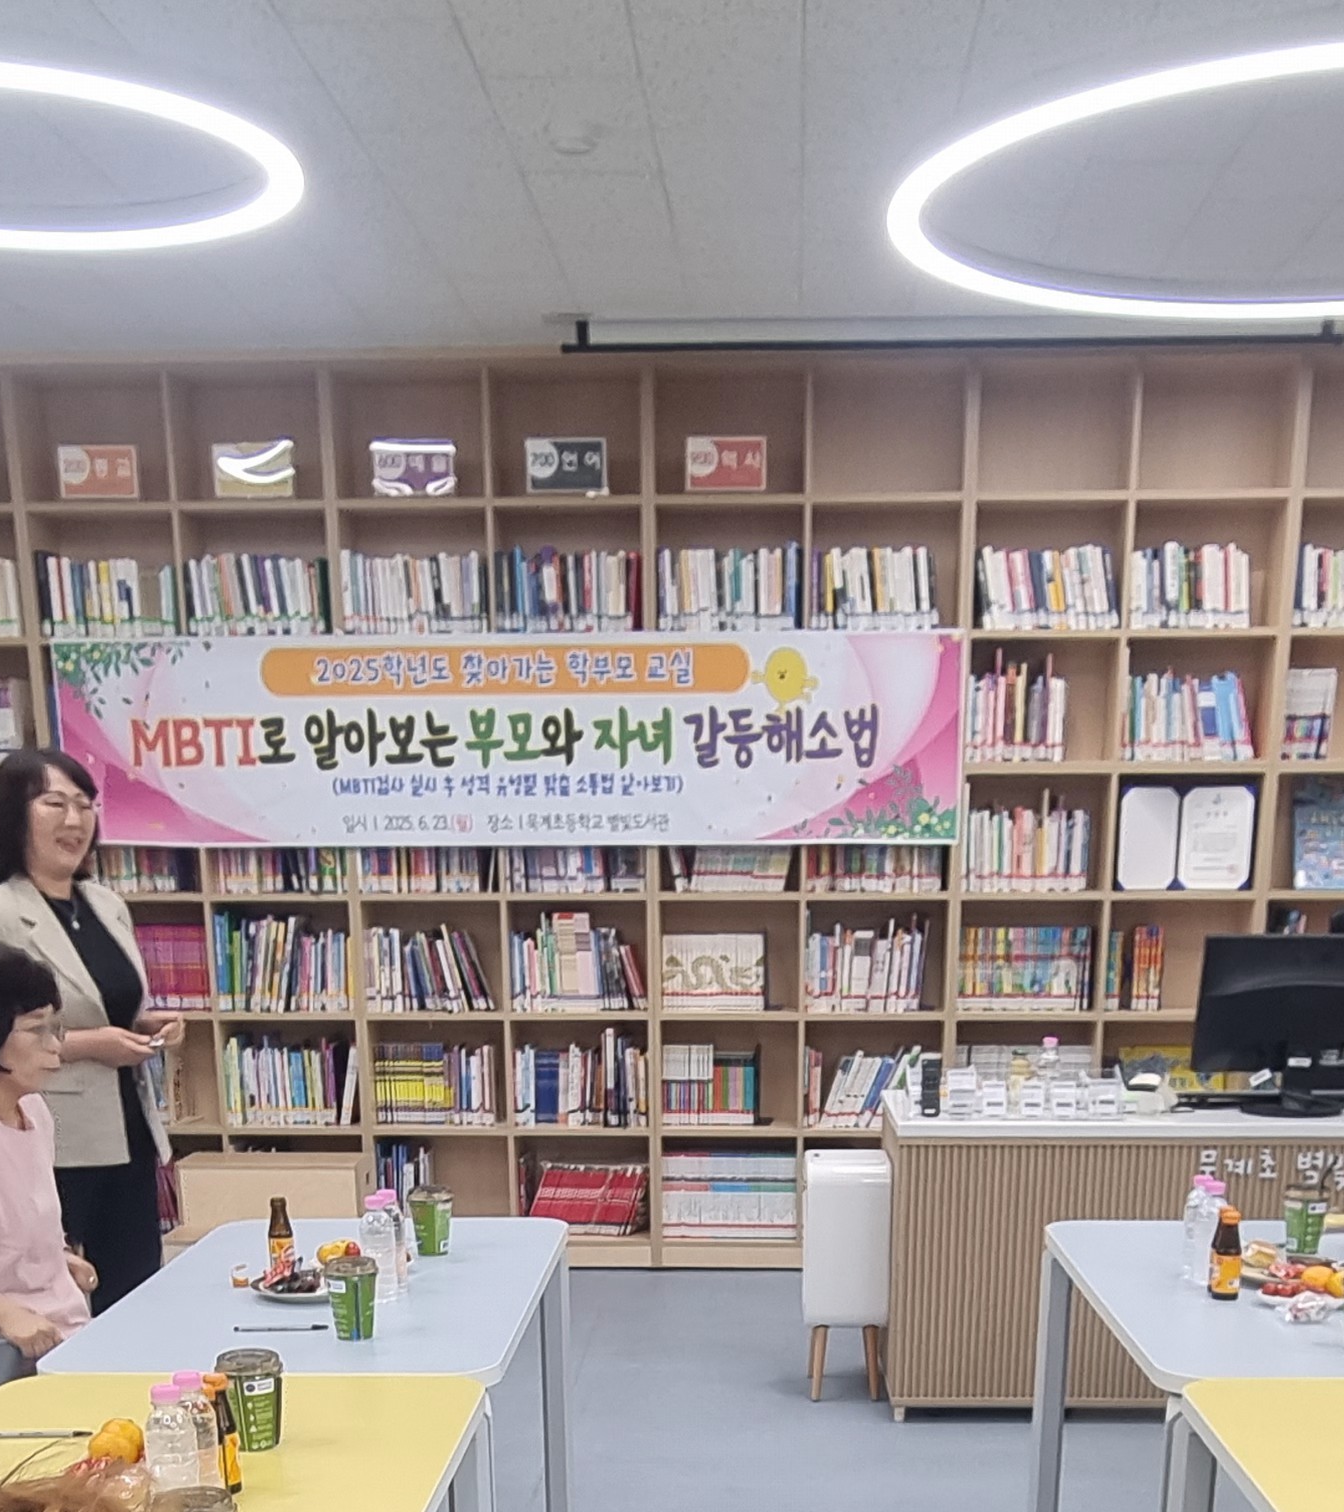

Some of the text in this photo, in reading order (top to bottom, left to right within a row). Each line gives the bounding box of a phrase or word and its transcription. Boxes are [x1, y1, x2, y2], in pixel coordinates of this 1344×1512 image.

[315, 651, 692, 686] 2025학년도 찾아가는 학부모 교실
[130, 703, 878, 770] MBTI로 알아보는 부모와 자녀 갈등해소법
[409, 775, 437, 796] 실시
[444, 776, 455, 797] 후
[460, 775, 490, 797] 성격
